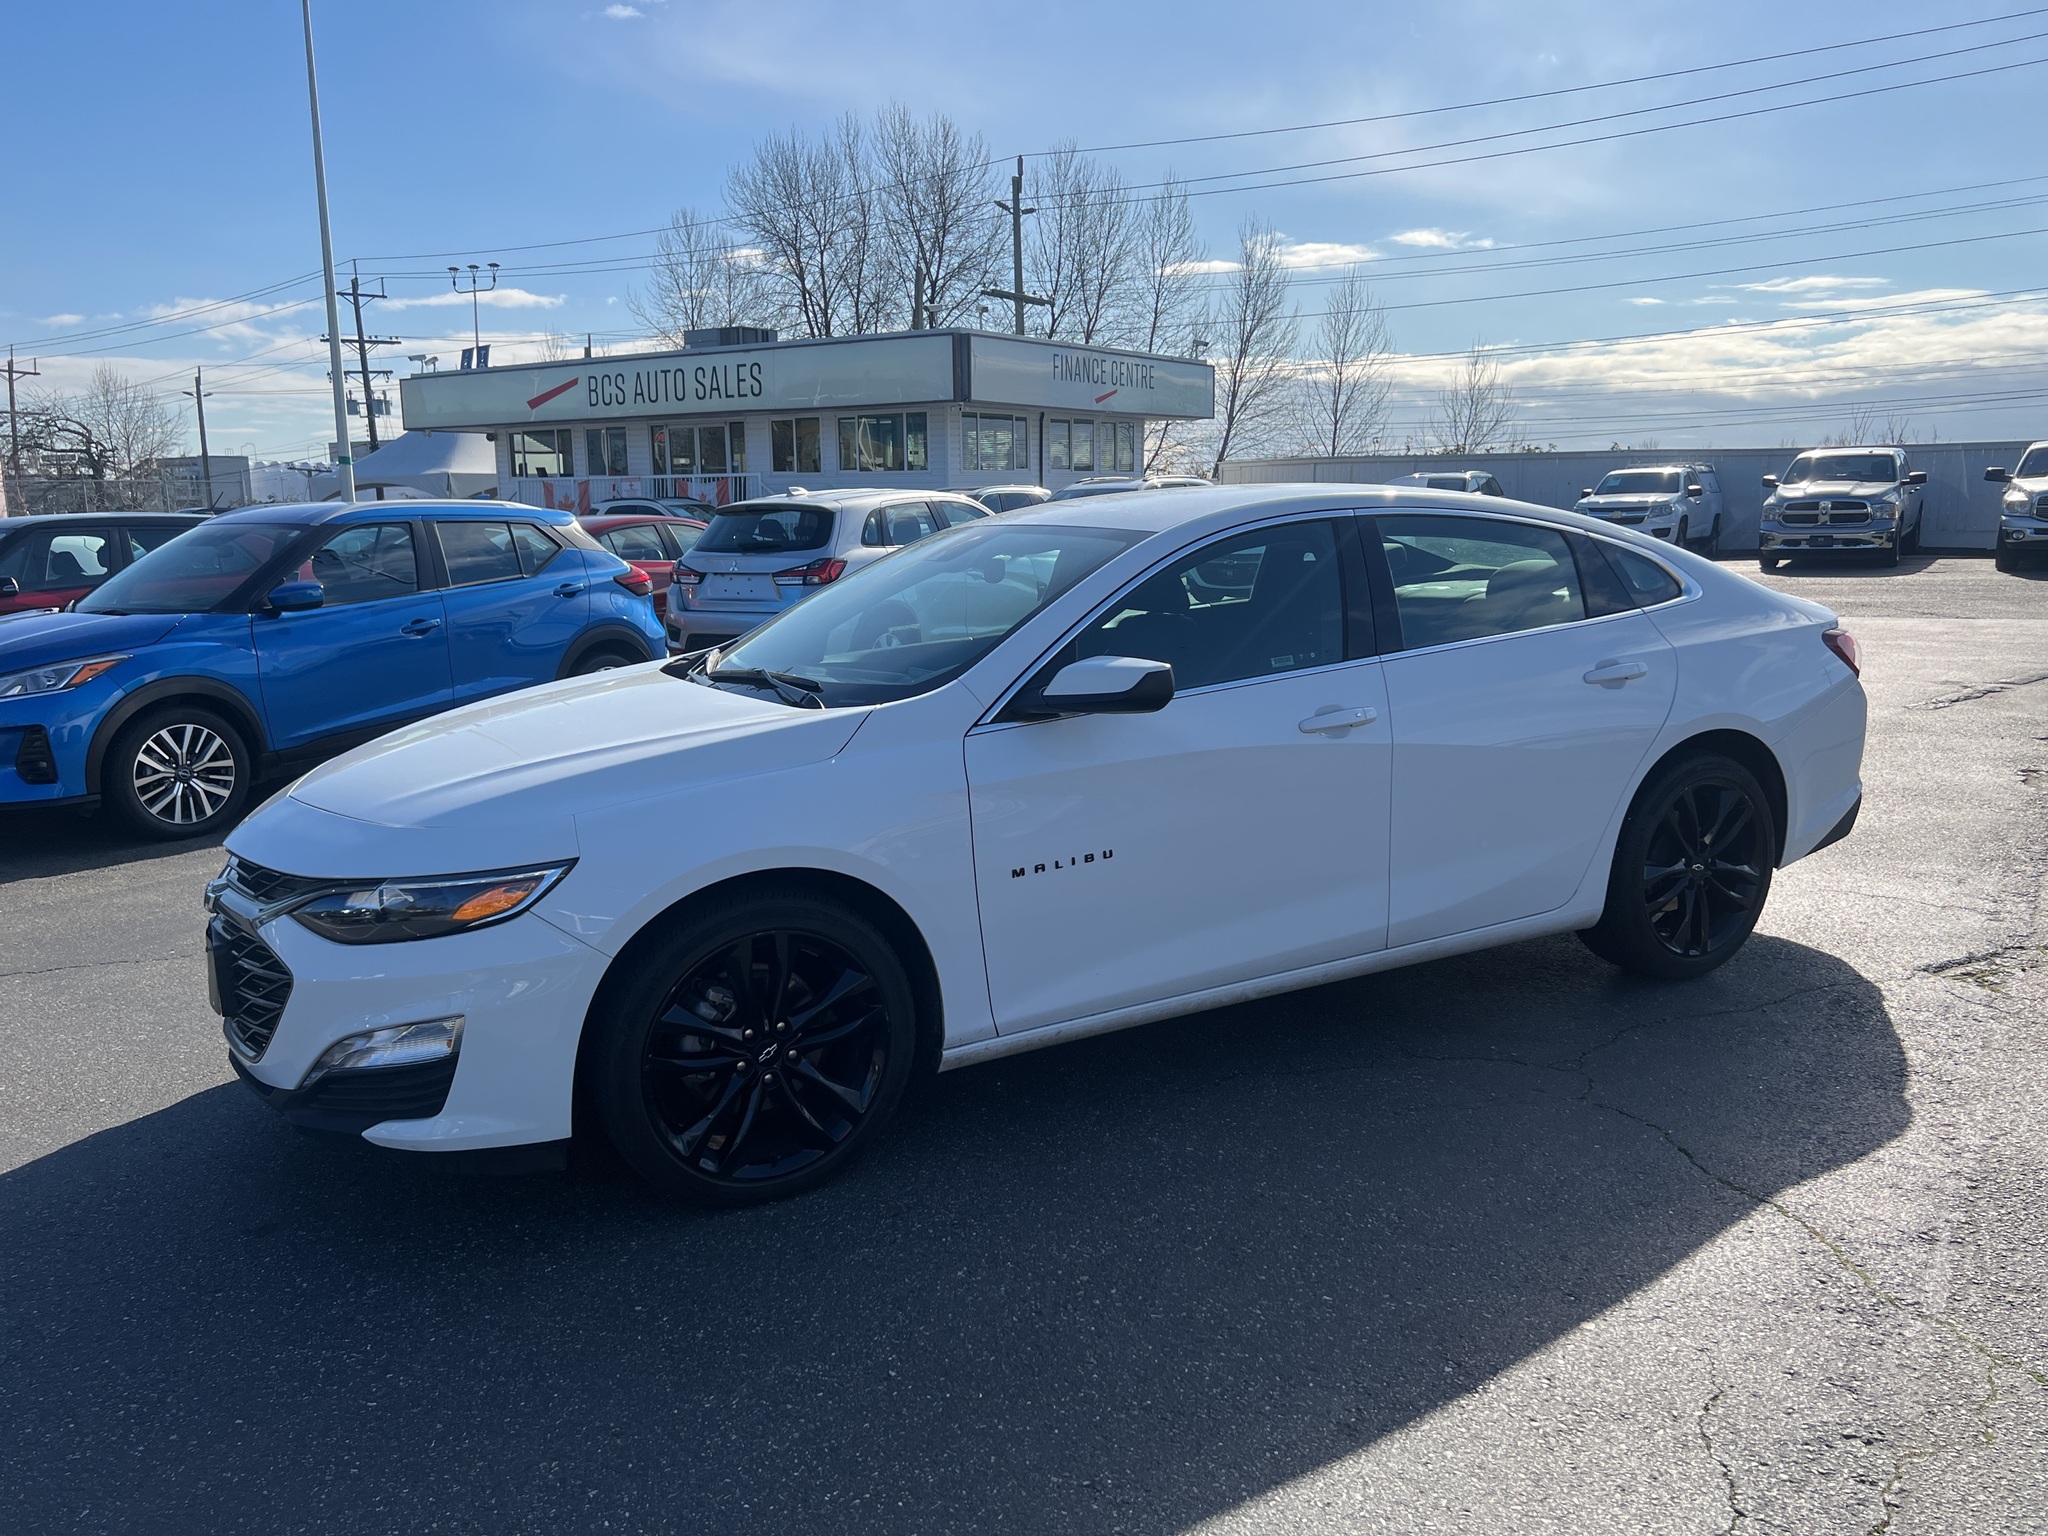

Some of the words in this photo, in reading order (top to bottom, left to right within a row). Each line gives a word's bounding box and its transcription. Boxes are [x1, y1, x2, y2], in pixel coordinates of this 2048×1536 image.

[588, 373, 626, 407] BCS
[634, 368, 686, 404] AUTO
[695, 362, 762, 400] SALES
[1053, 353, 1107, 385] FINANCE
[1111, 361, 1155, 389] CENTRE
[1011, 849, 1114, 879] MALIBU
